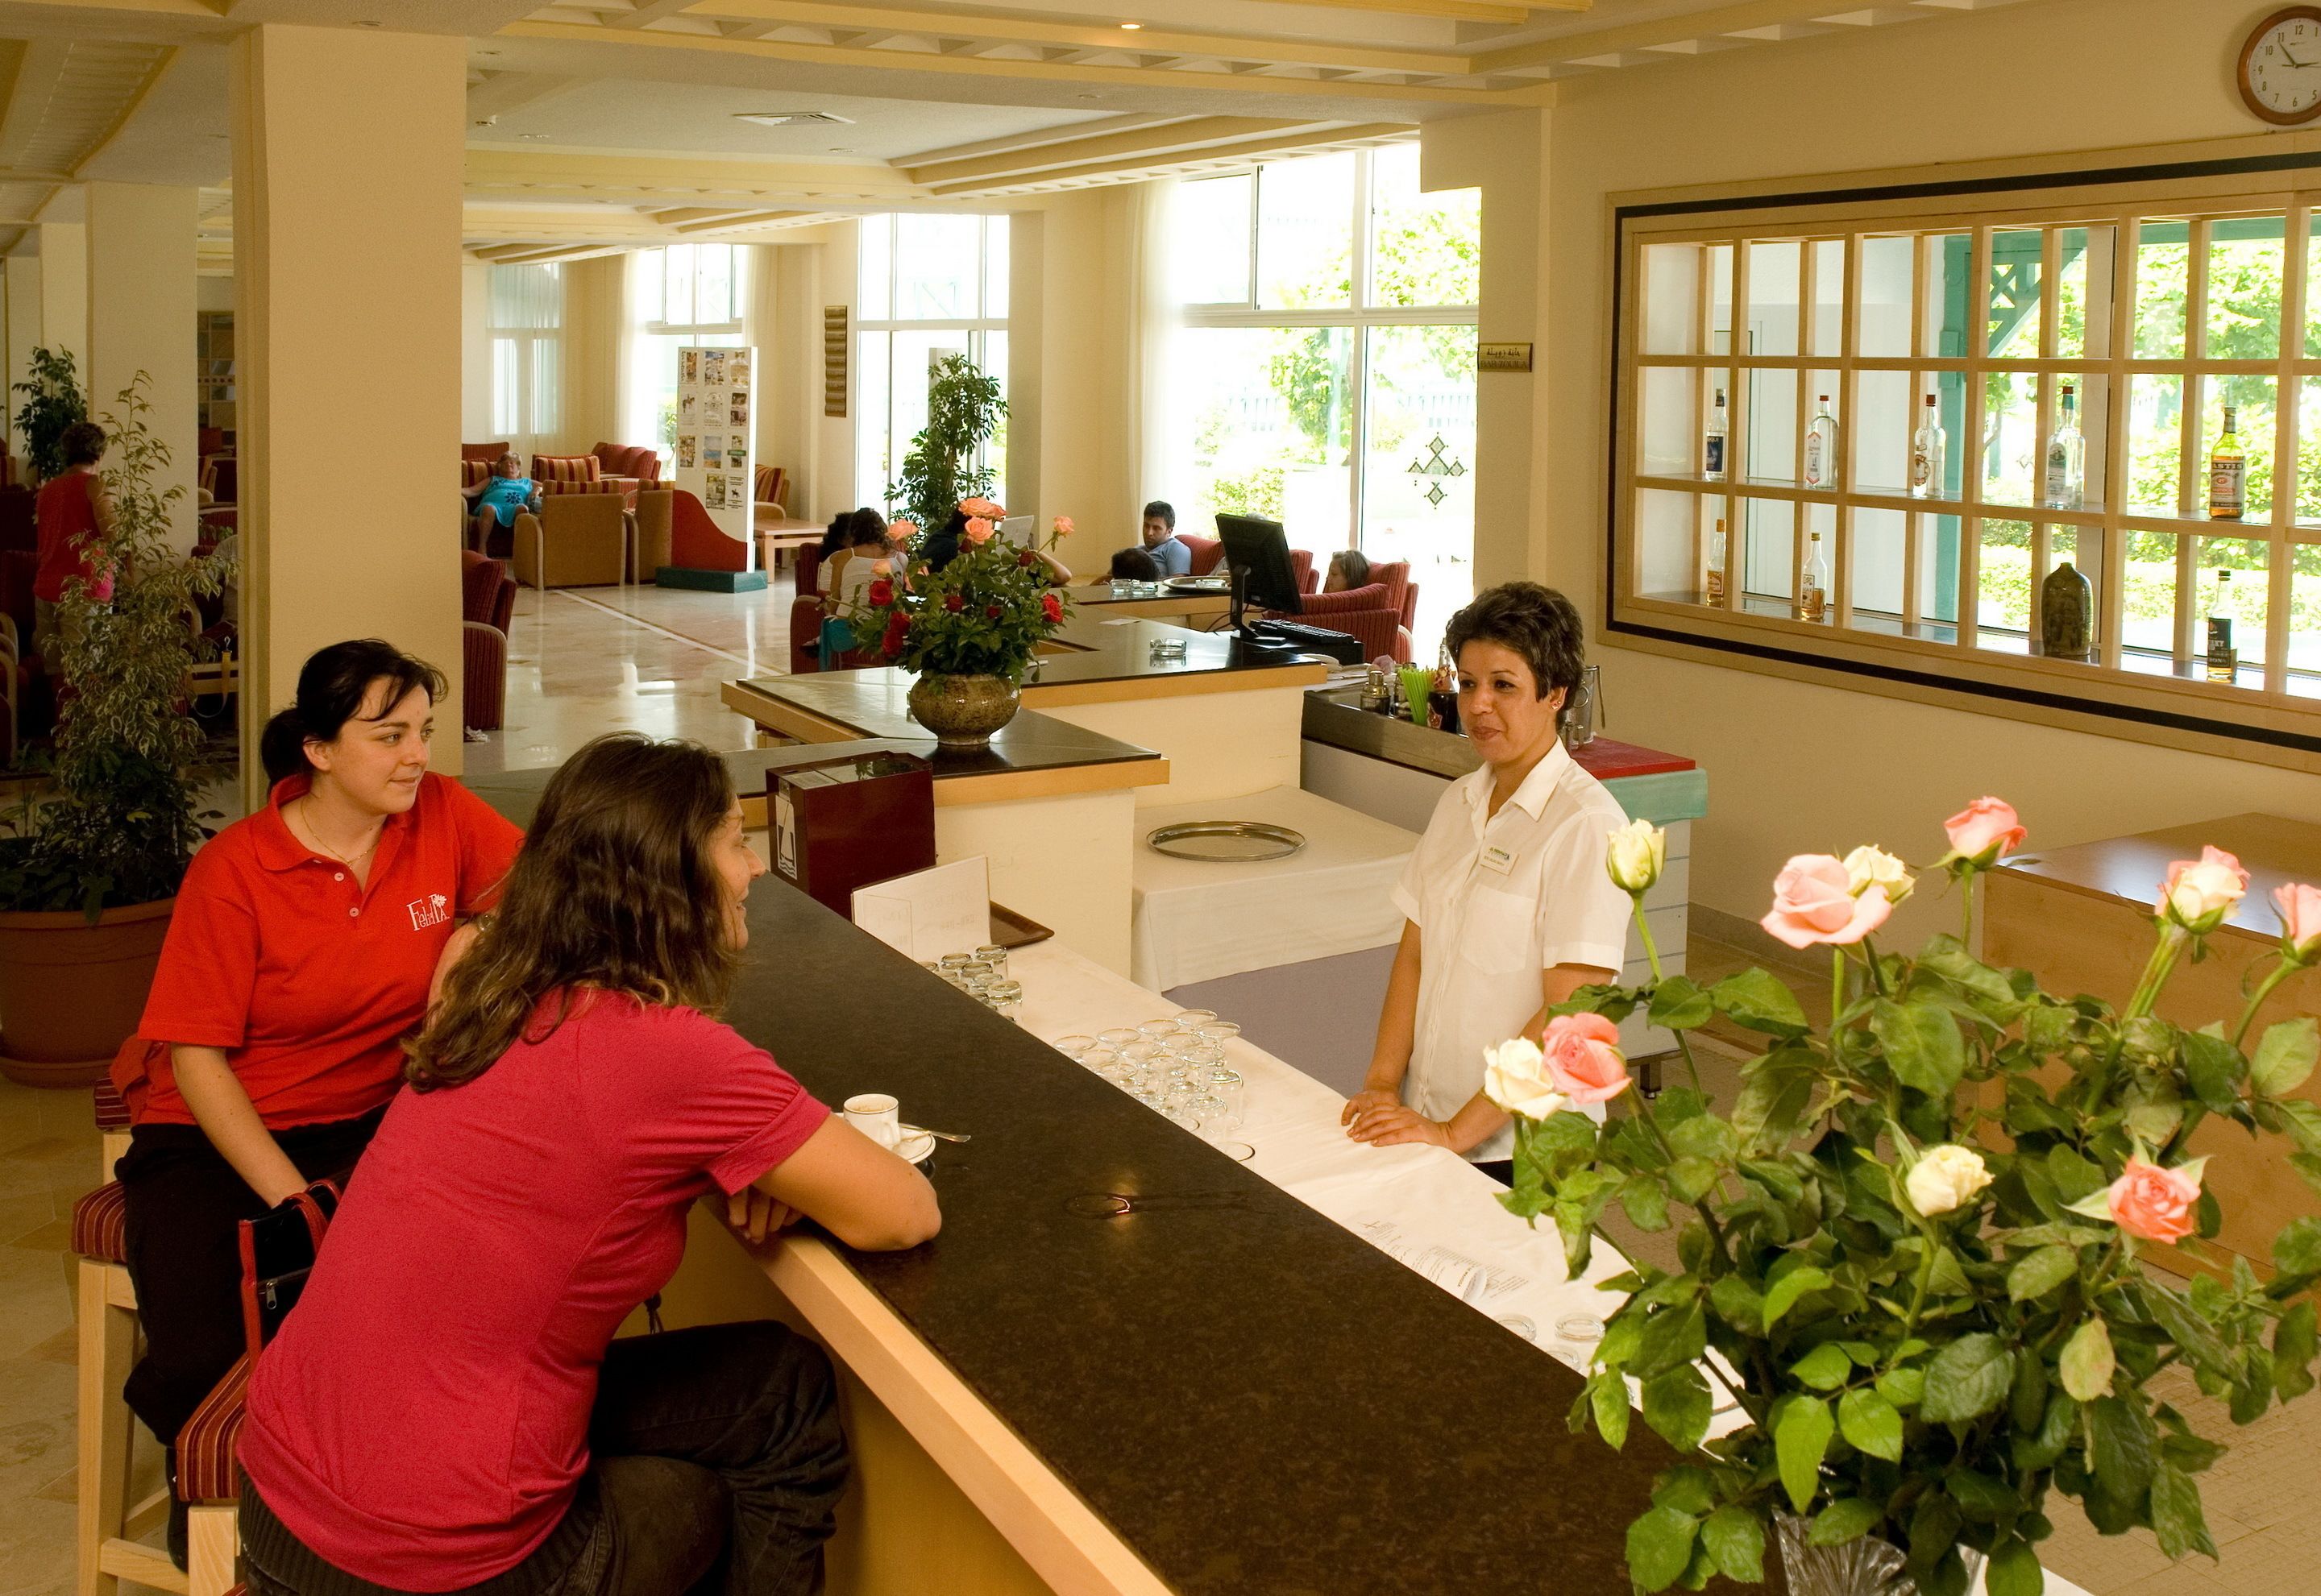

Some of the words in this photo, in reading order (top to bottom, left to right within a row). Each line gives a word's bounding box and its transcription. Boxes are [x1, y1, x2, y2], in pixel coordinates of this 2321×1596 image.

[2295, 25, 2303, 35] 12
[2315, 27, 2319, 37] 1
[2278, 32, 2284, 43] 11
[2265, 46, 2273, 56] 10
[2258, 65, 2263, 75] 9
[2262, 81, 2267, 91] 8
[2274, 93, 2280, 103] 7
[2312, 90, 2317, 100] 5
[2293, 97, 2298, 107] 6
